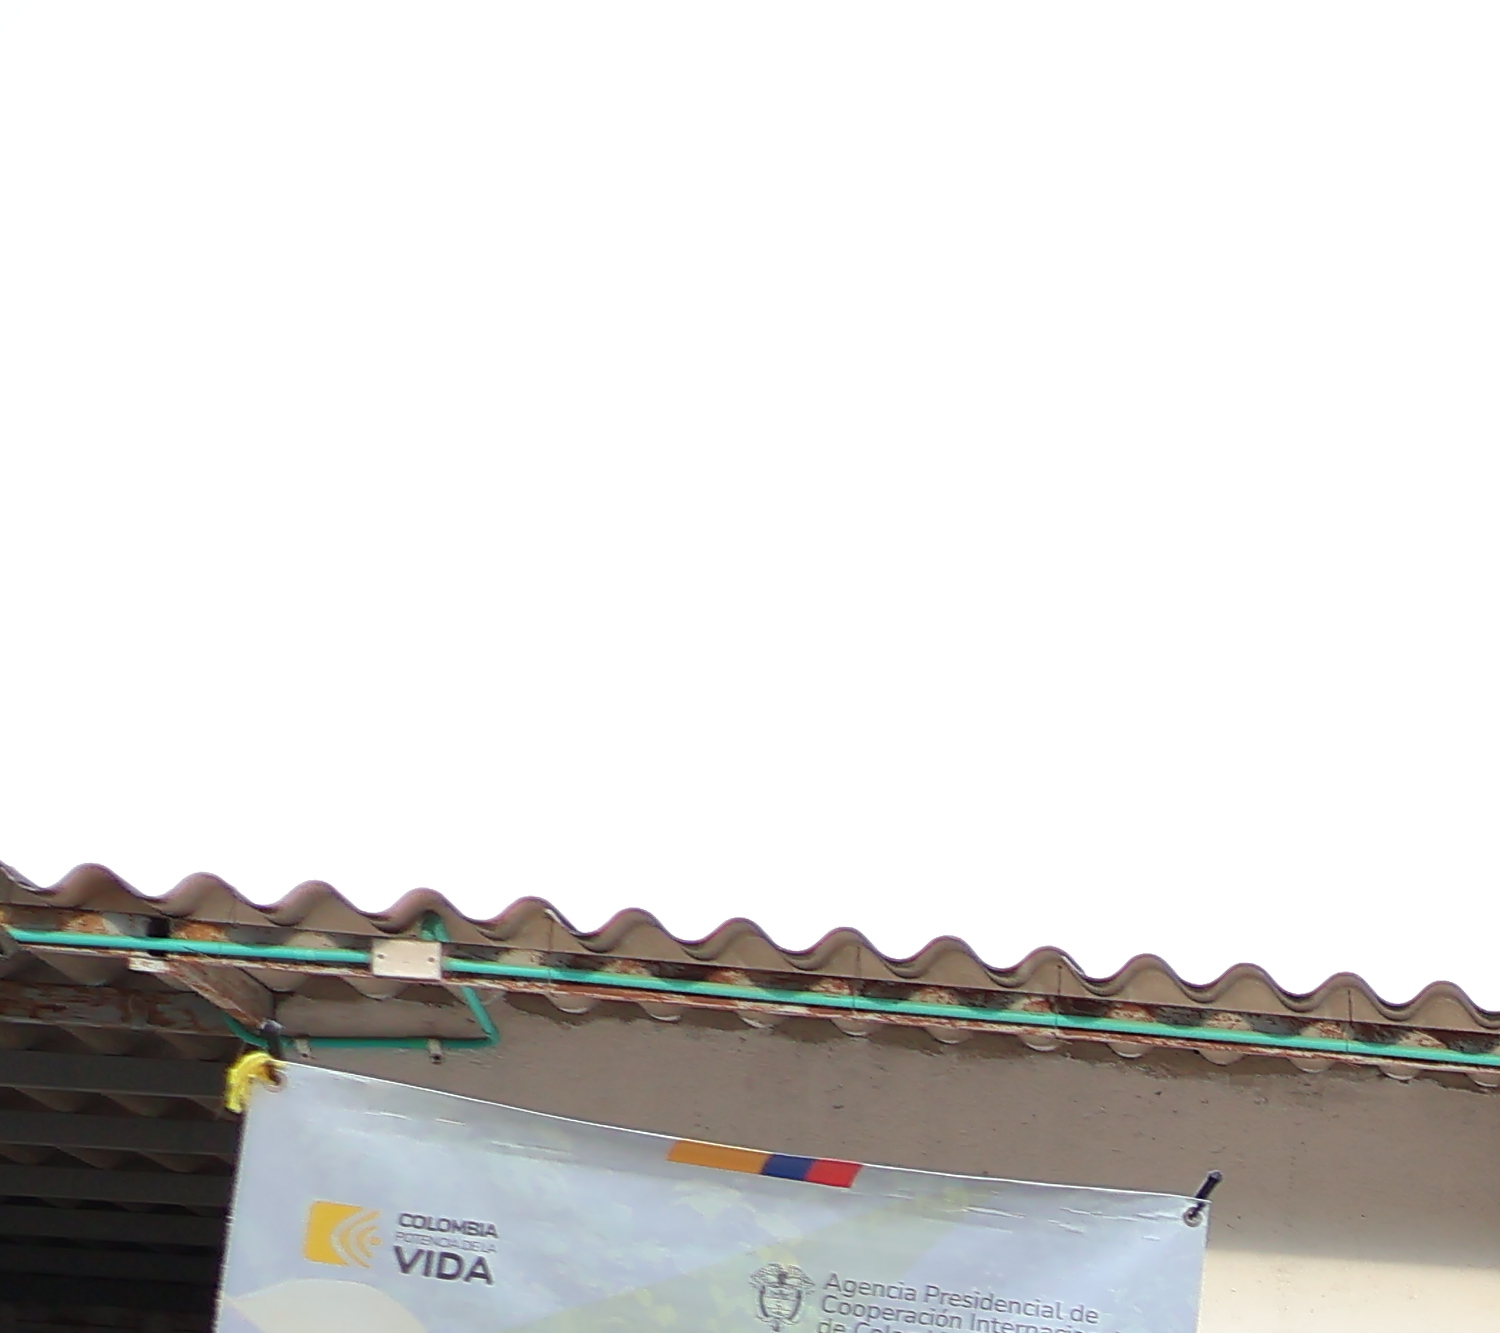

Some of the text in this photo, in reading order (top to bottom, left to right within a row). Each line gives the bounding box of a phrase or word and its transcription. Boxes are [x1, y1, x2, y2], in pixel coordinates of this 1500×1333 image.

[396, 1231, 458, 1249] POTENCIA
[398, 1213, 499, 1238] COLOMBIA
[393, 1245, 494, 1286] VIDA
[821, 1296, 962, 1330] Cooperación
[823, 1273, 1099, 1324] Agencia Presidencial de
